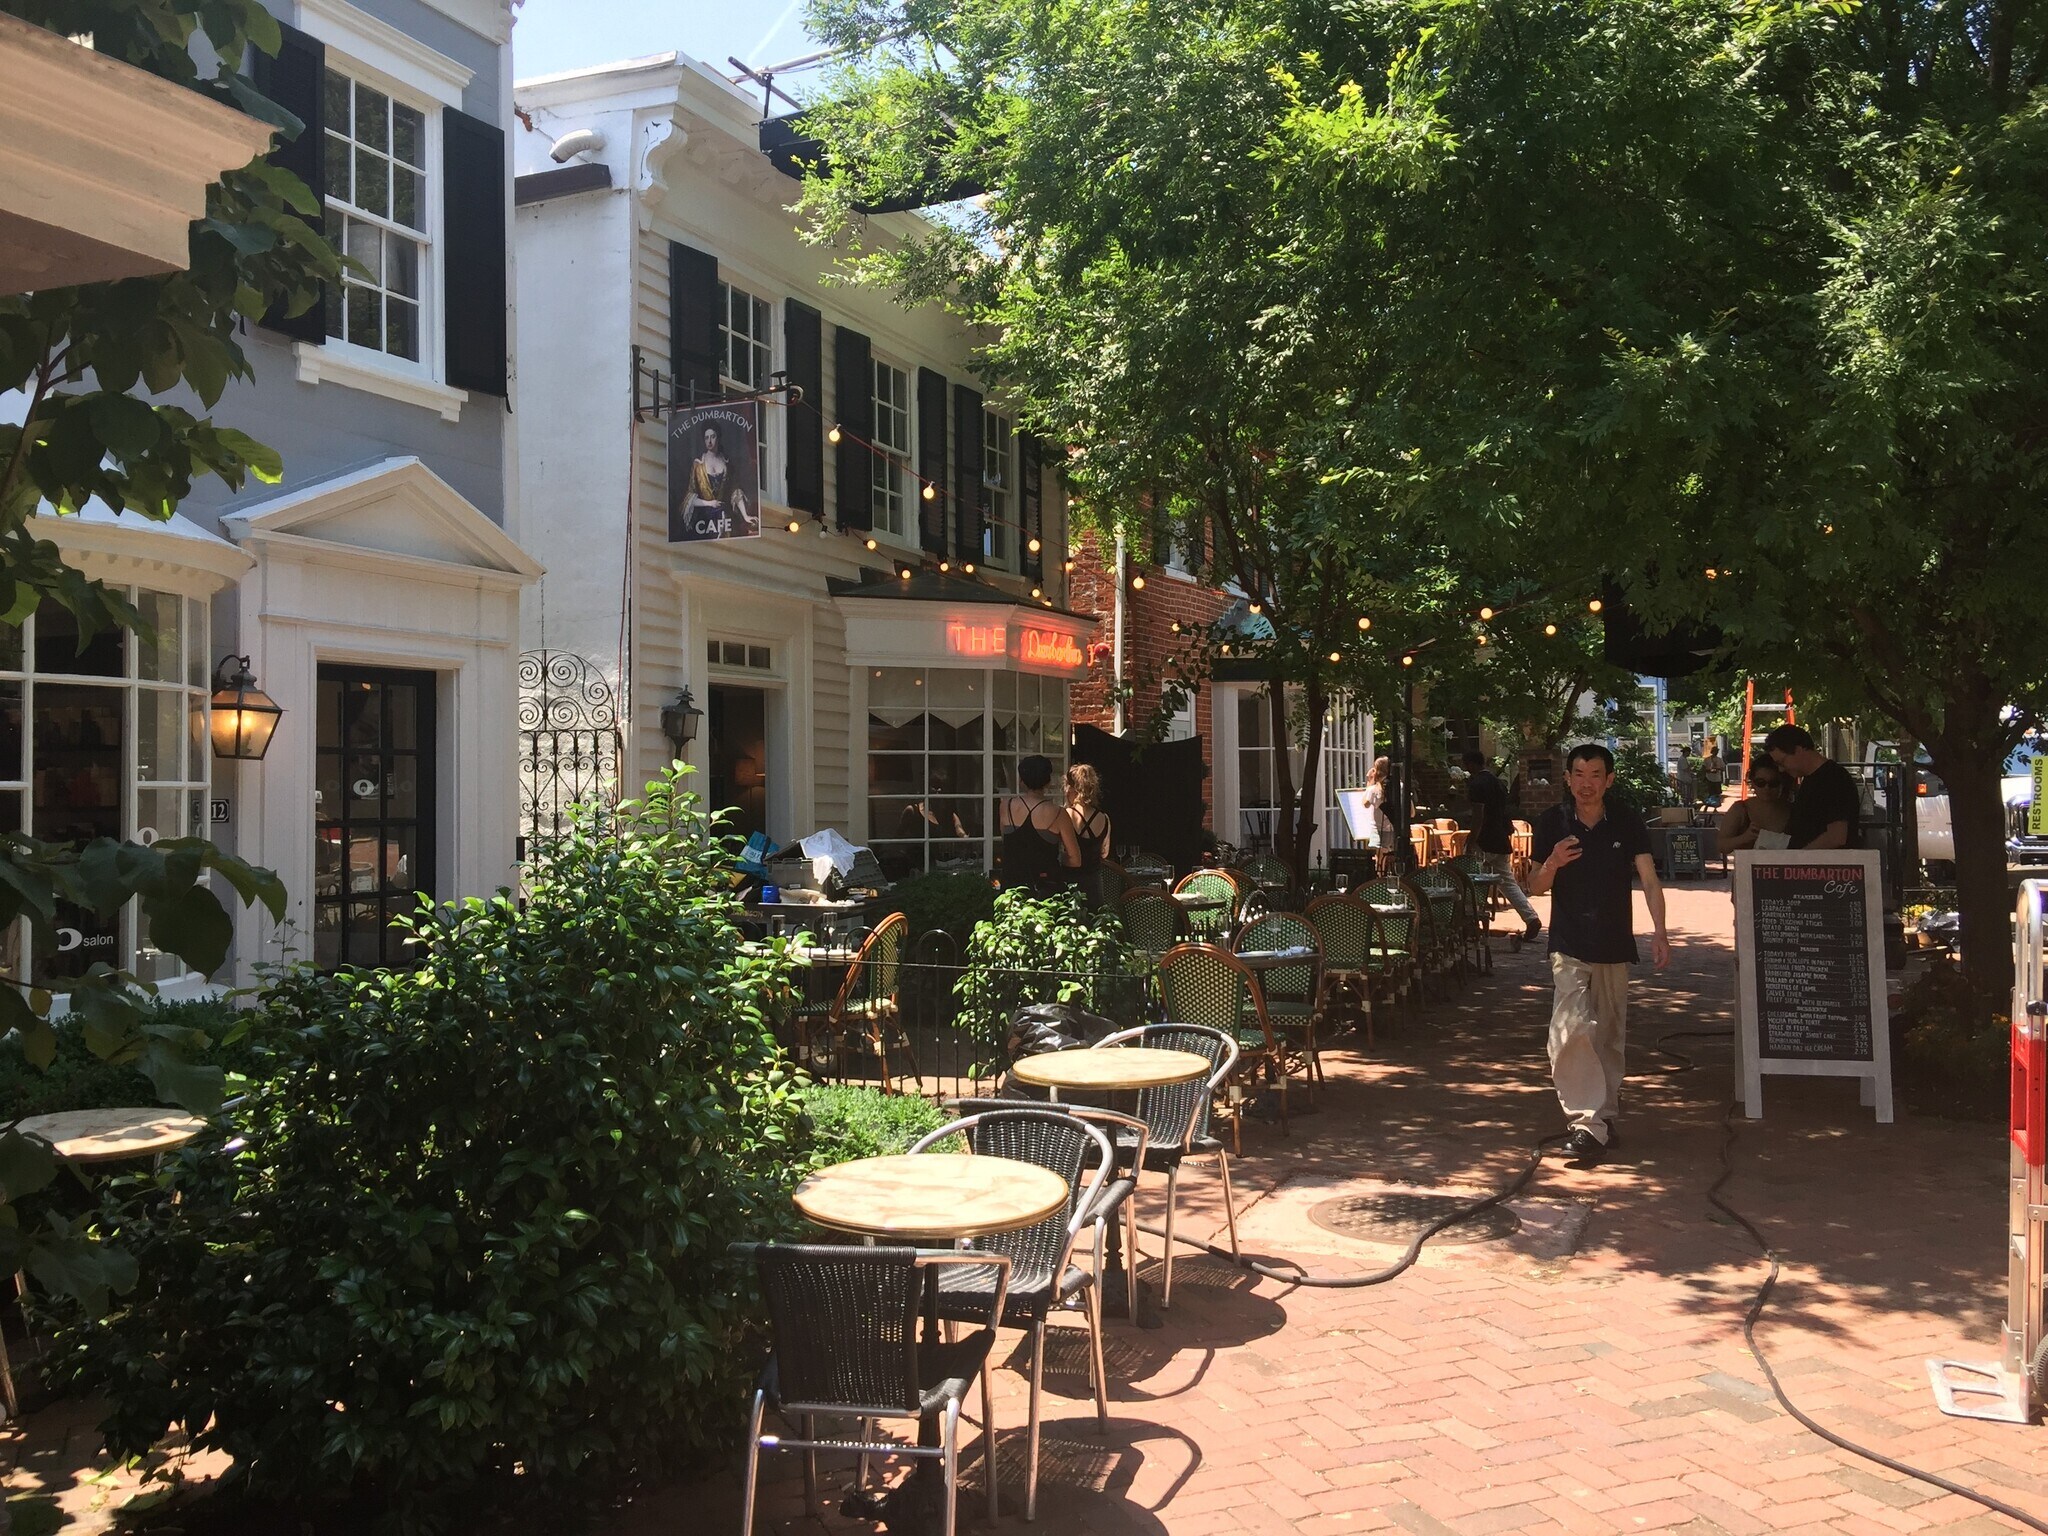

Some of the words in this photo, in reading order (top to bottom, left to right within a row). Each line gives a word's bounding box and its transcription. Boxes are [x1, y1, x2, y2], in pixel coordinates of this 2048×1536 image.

[671, 422, 692, 439] THE
[692, 410, 754, 433] DUMBARTON
[695, 518, 733, 536] CAFE
[951, 626, 1006, 653] THE
[2031, 758, 2044, 831] RESTROOMS
[1754, 868, 1780, 879] THE
[1784, 868, 1863, 881] DUMBARTON
[1824, 880, 1859, 899] Cafe
[83, 933, 115, 947] salon
